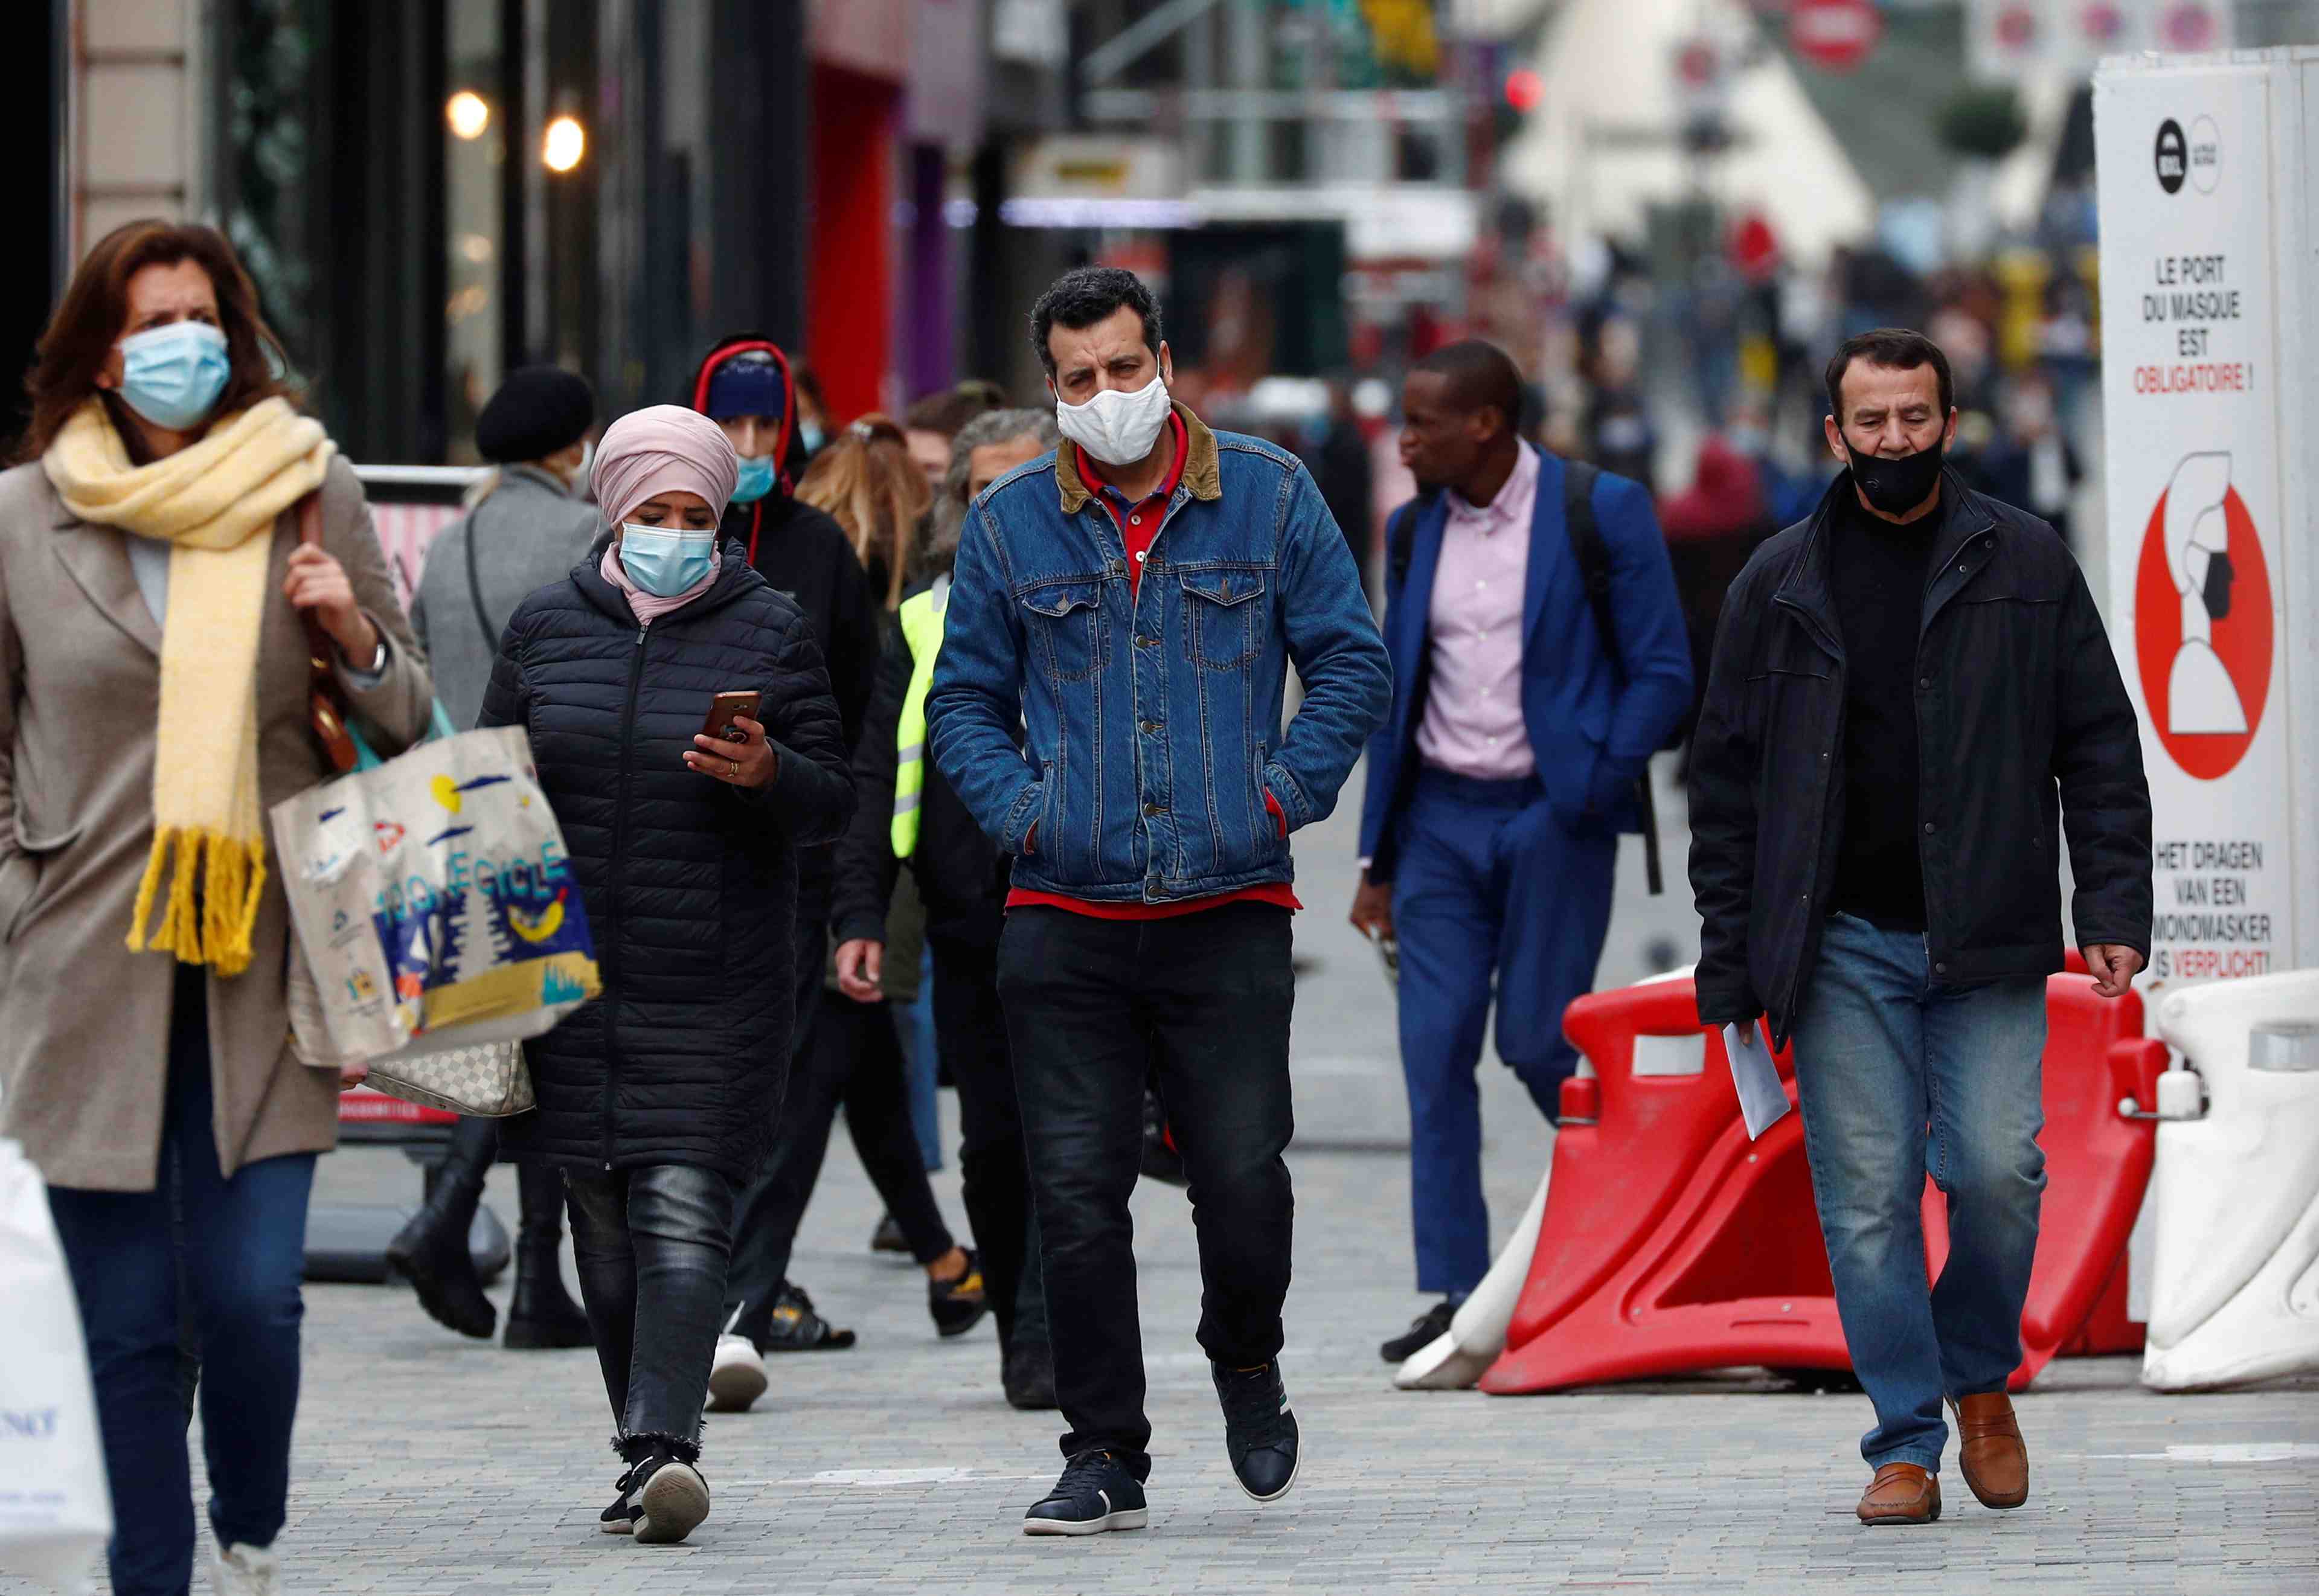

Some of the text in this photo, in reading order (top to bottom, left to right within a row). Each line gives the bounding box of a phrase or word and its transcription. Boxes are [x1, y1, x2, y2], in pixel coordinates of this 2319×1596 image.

[2157, 256, 2225, 285] LE PORT
[2143, 292, 2240, 321] DU MASQUE
[2178, 330, 2208, 356] EST
[2134, 364, 2243, 394] OBLIGATOIRE
[2157, 842, 2262, 869] HET DRAGEN
[2176, 879, 2245, 905] VAN EEN
[2153, 914, 2271, 941] MONDMASKER
[2156, 950, 2170, 976] IS
